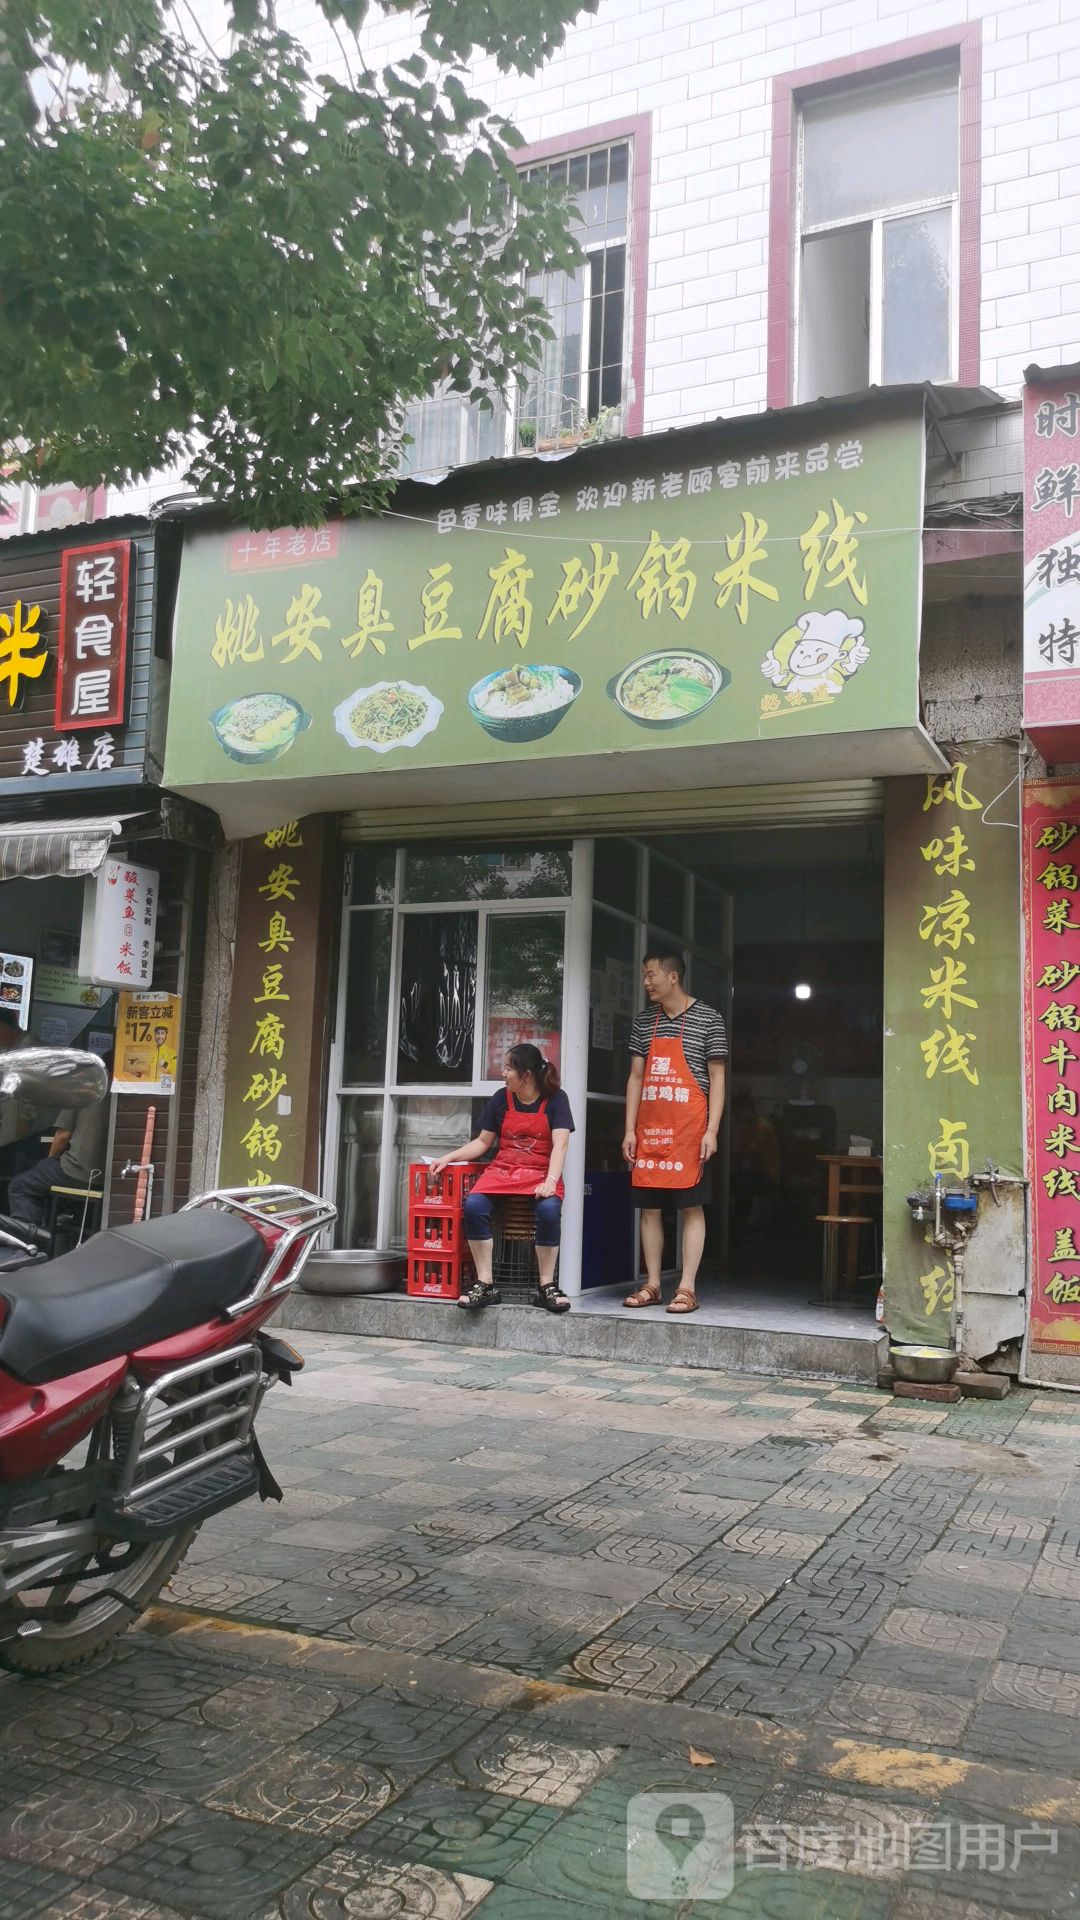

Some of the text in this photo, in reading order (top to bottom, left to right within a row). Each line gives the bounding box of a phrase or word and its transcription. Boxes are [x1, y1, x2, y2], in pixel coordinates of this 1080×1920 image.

[238, 529, 332, 563] 十年老店
[437, 440, 864, 534] 色香味俱全 欢迎新老顾客前来品尝
[71, 556, 116, 716] 轻食屋
[210, 498, 869, 668] 姚安臭豆腐砂锅米线
[21, 732, 116, 777] 楚雄店
[919, 761, 983, 1086] 风味凉米线
[126, 1005, 174, 1020] 新客立减
[1034, 821, 1080, 1305] 砂锅菜 砂锅牛肉米线 盖饭
